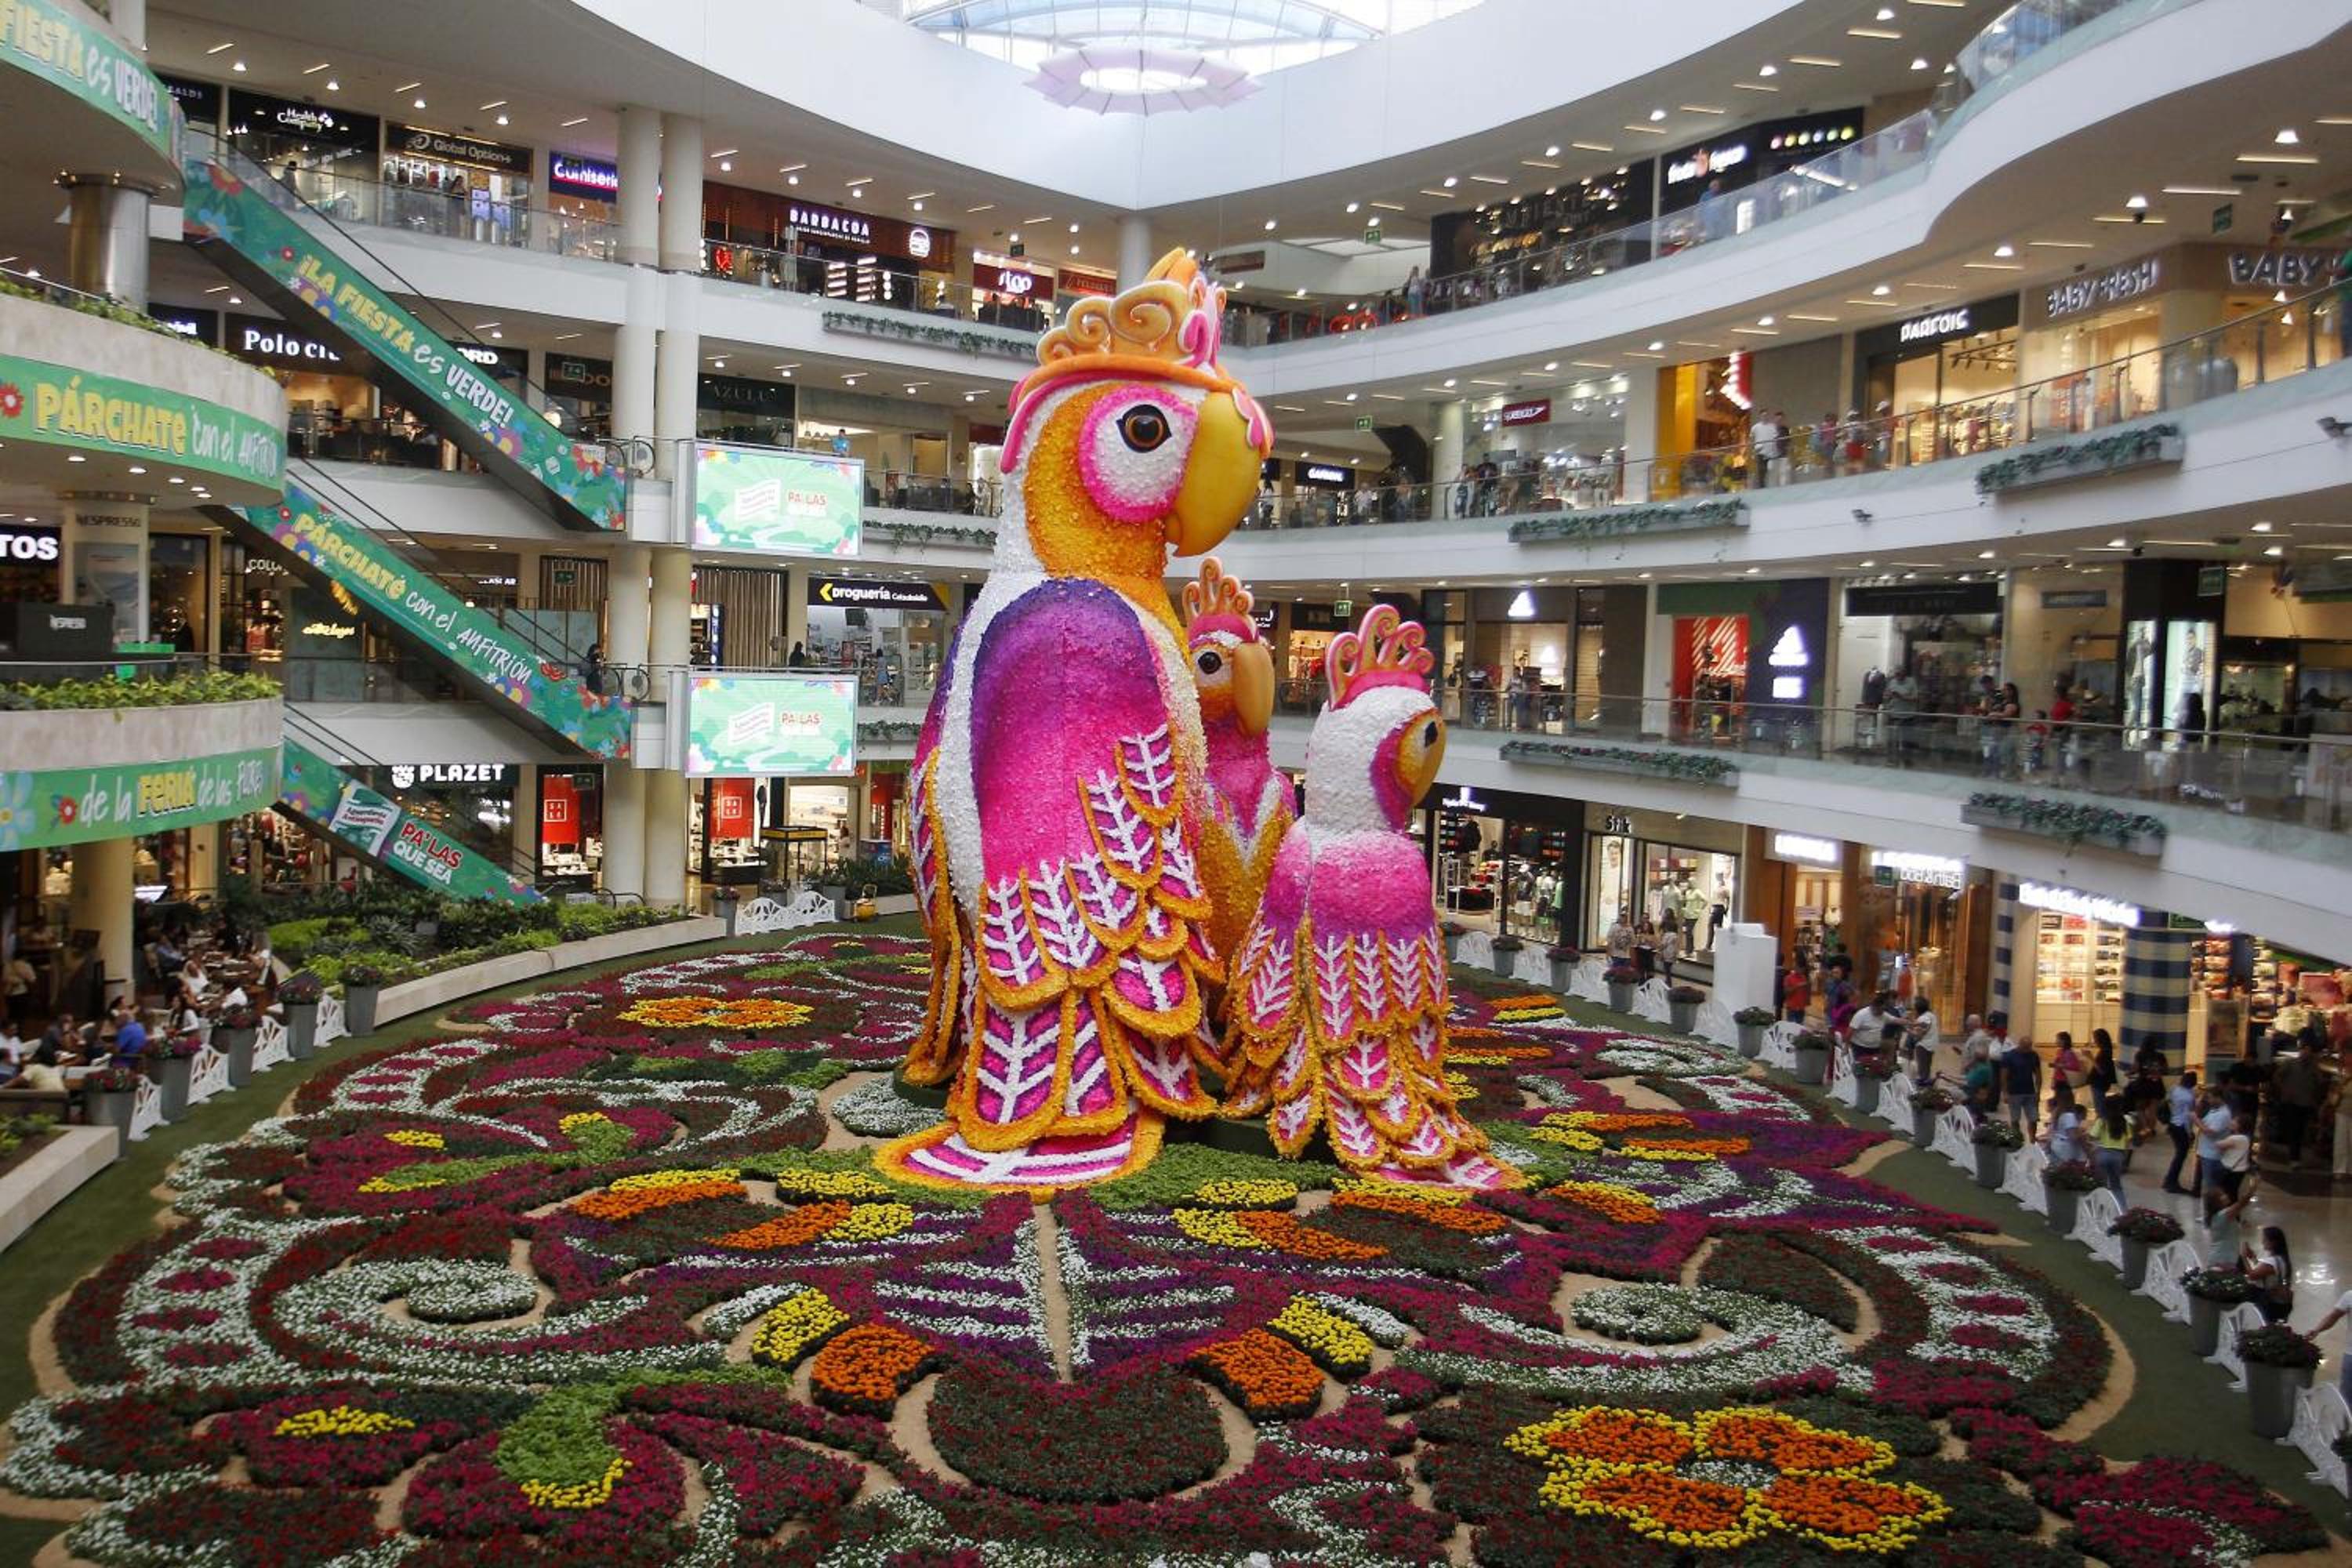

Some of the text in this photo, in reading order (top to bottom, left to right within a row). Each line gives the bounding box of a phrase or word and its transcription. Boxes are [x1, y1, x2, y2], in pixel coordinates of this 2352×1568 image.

[433, 140, 466, 156] Global
[789, 208, 870, 237] BARBACOA
[2046, 278, 2097, 319] BABY
[244, 330, 300, 356] Polo
[337, 283, 415, 352] FIESTA
[414, 344, 445, 374] es
[445, 365, 515, 428] VERDE!
[832, 586, 891, 601] Droguería
[405, 590, 436, 621] con
[435, 611, 457, 633] el
[456, 627, 533, 685] ANFITRIÓN
[419, 764, 505, 782] PLAZET
[80, 774, 109, 828] de
[114, 775, 132, 822] la
[394, 840, 452, 885] QUE SEA
